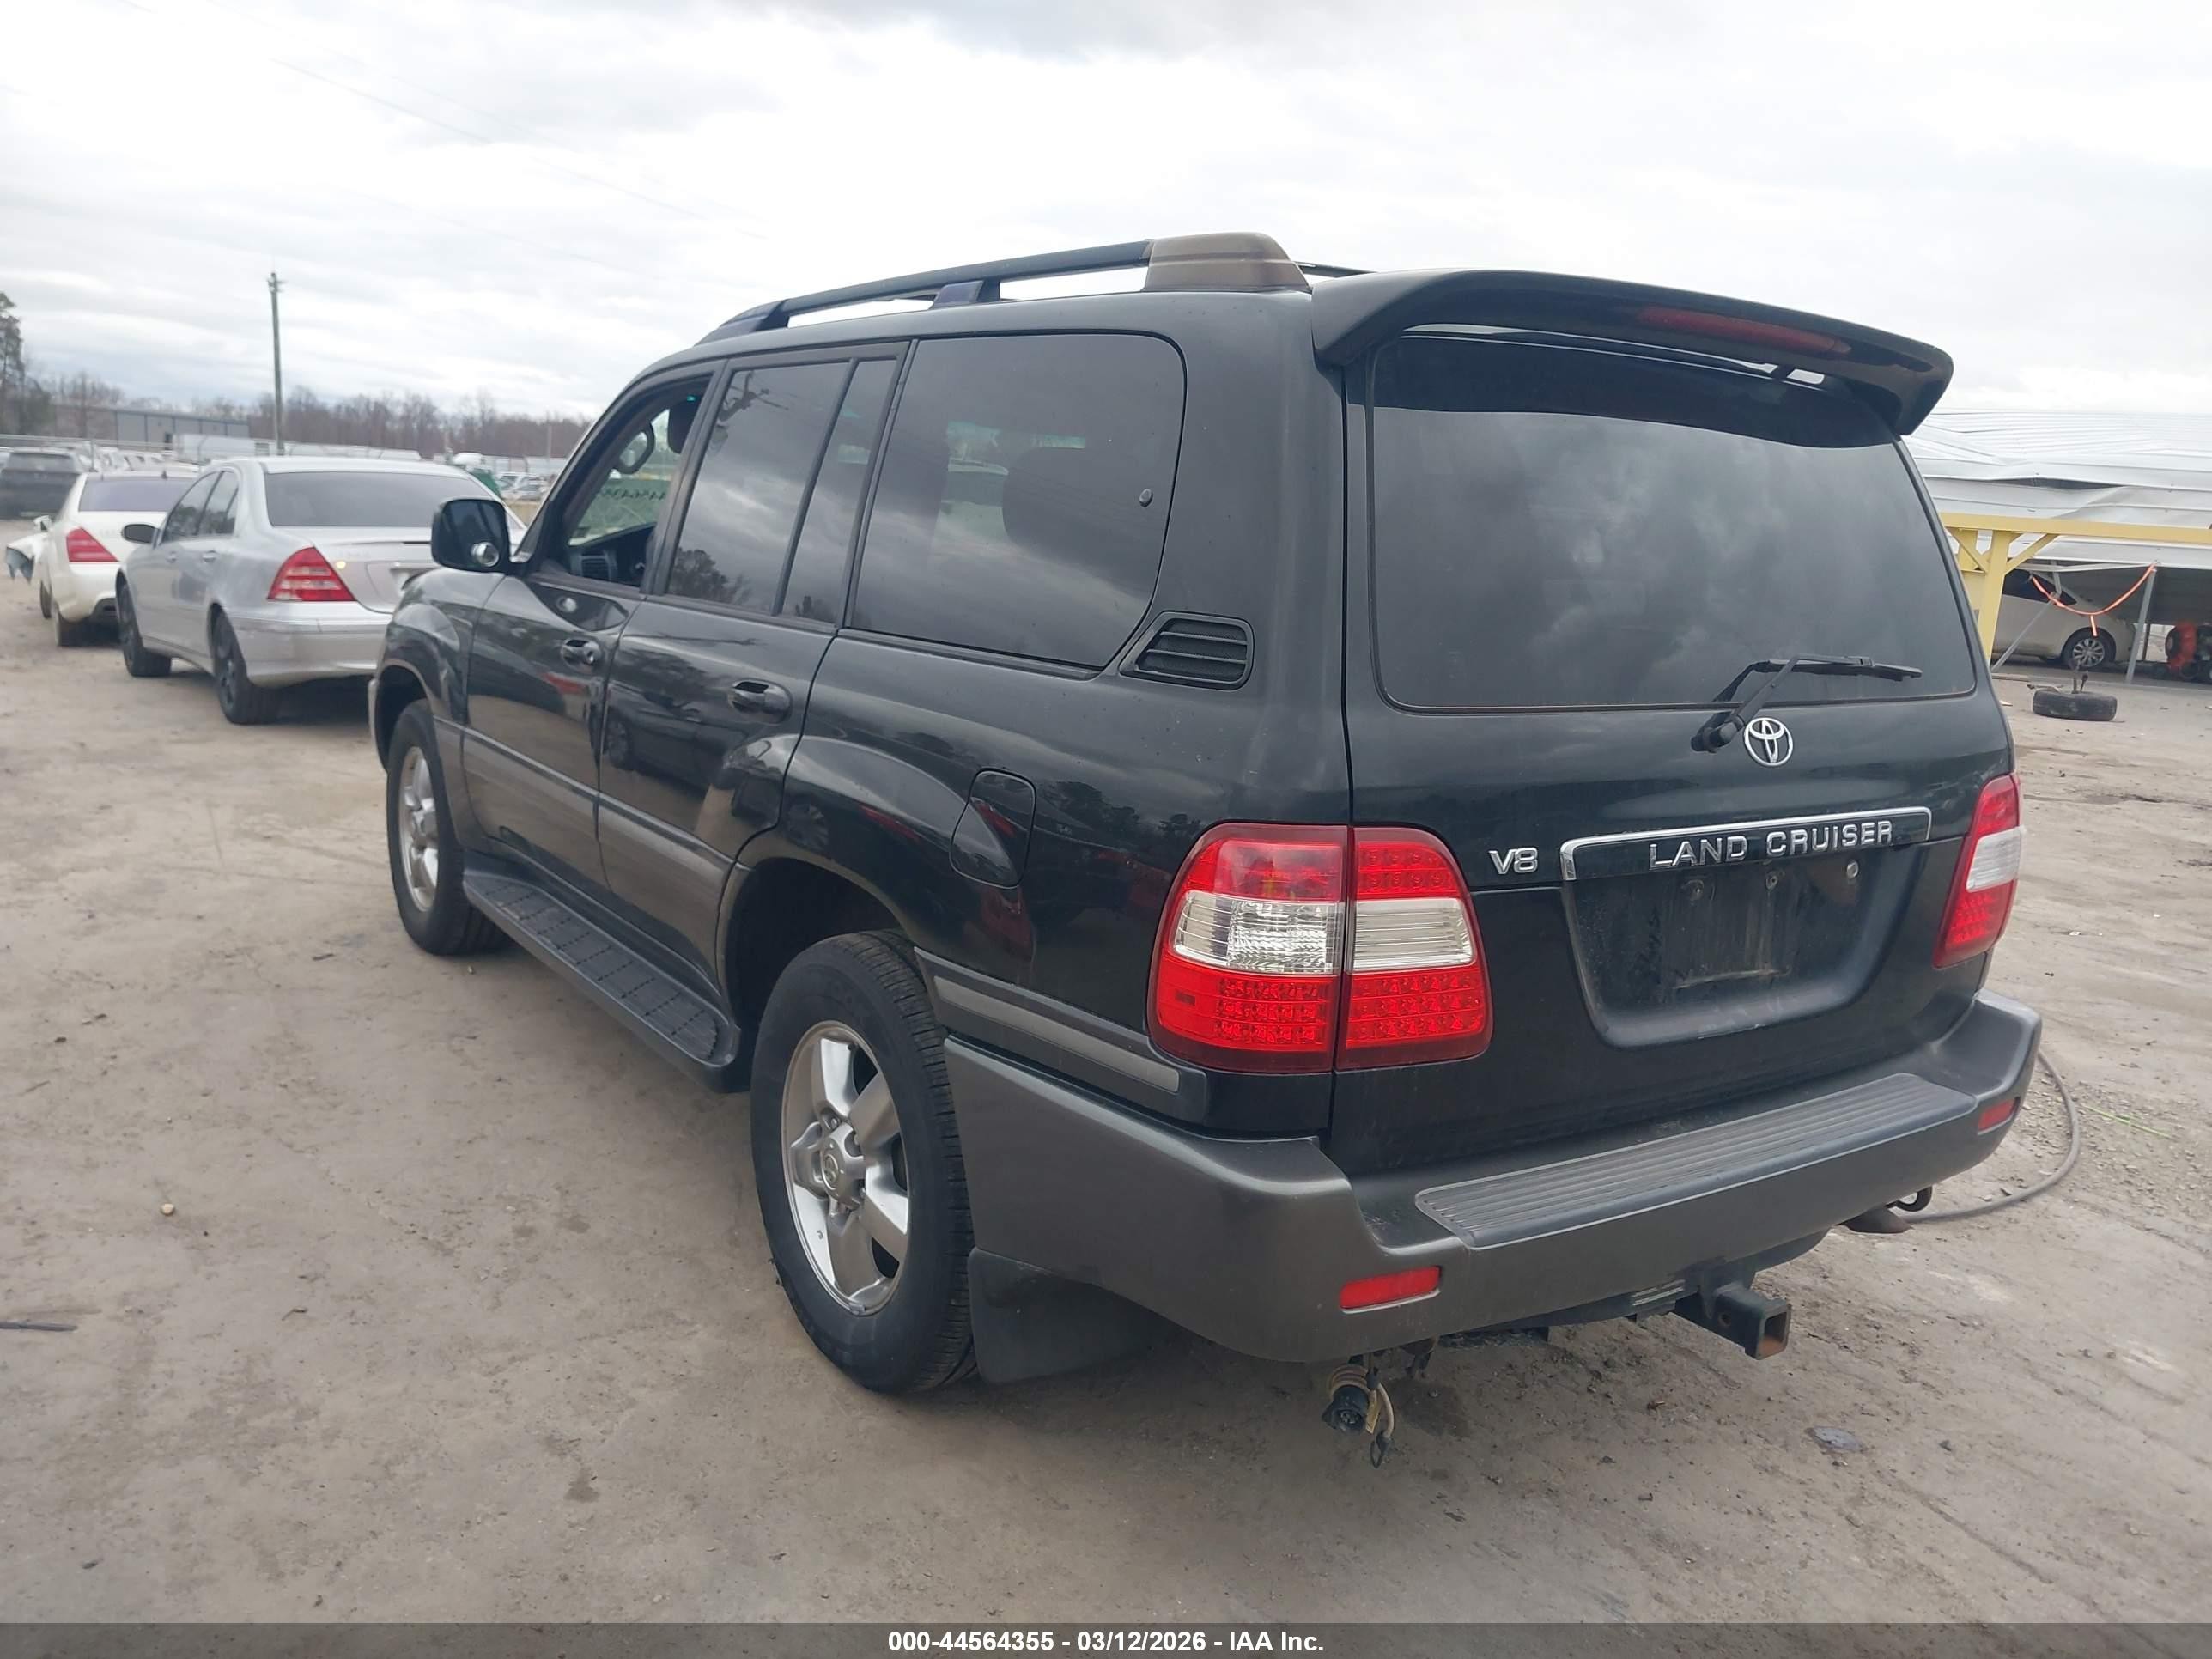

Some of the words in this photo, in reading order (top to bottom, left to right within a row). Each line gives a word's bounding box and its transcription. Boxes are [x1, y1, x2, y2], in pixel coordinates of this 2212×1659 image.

[1489, 847, 1539, 874] V8
[1649, 835, 1747, 871] LAND
[1766, 820, 1893, 856] CRUISER
